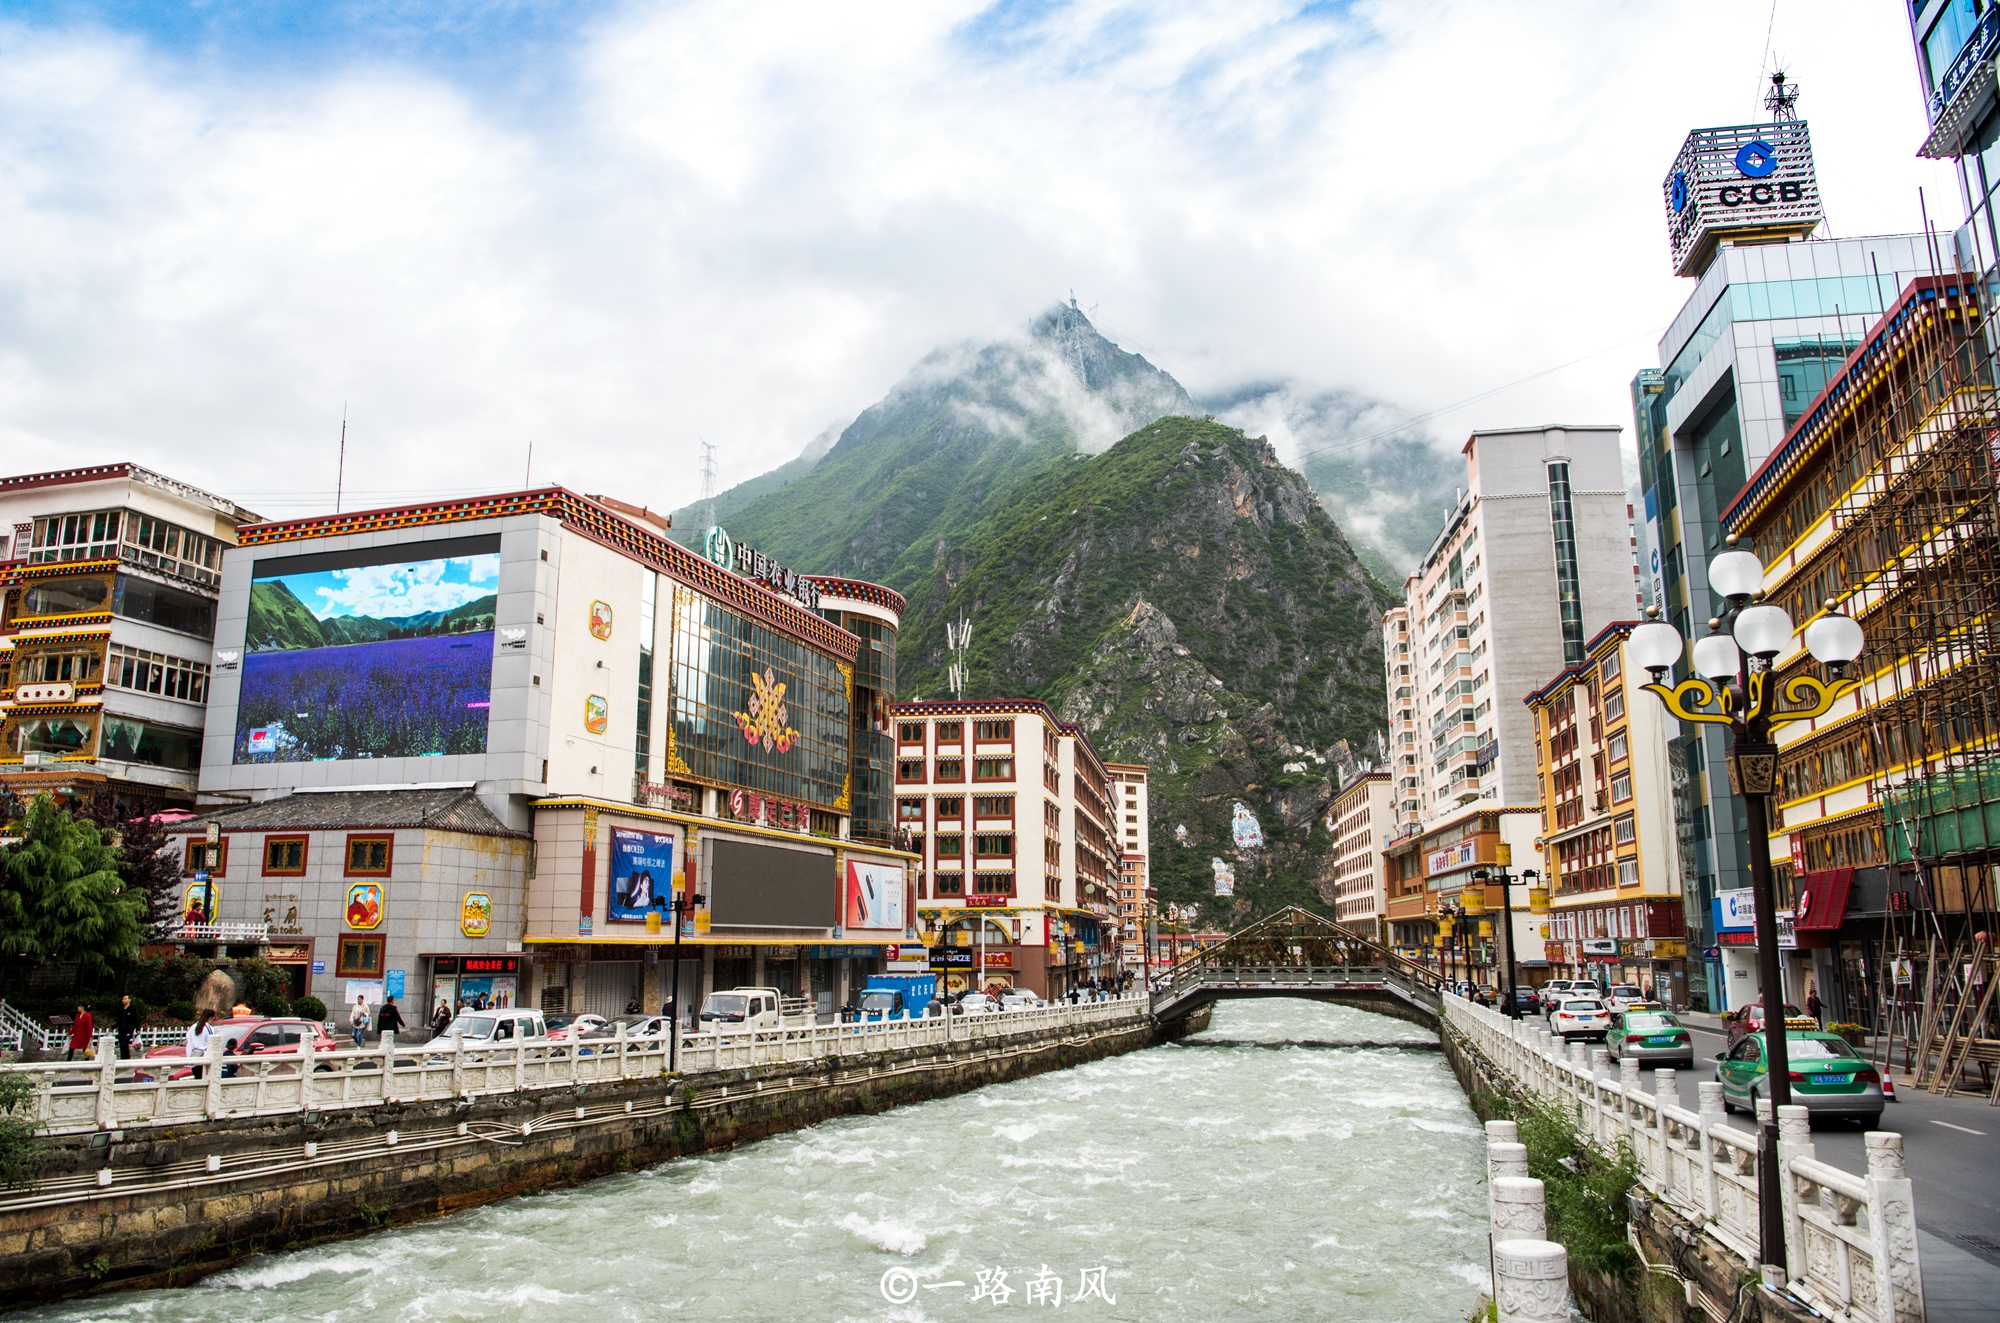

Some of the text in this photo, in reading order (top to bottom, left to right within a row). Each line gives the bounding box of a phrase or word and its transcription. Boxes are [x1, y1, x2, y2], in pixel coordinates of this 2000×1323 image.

[1719, 181, 1803, 207] CCB
[735, 542, 822, 608] 中国农业银行
[747, 793, 810, 829] 康定百货
[263, 905, 298, 926] 公厕
[279, 925, 303, 934] toilet
